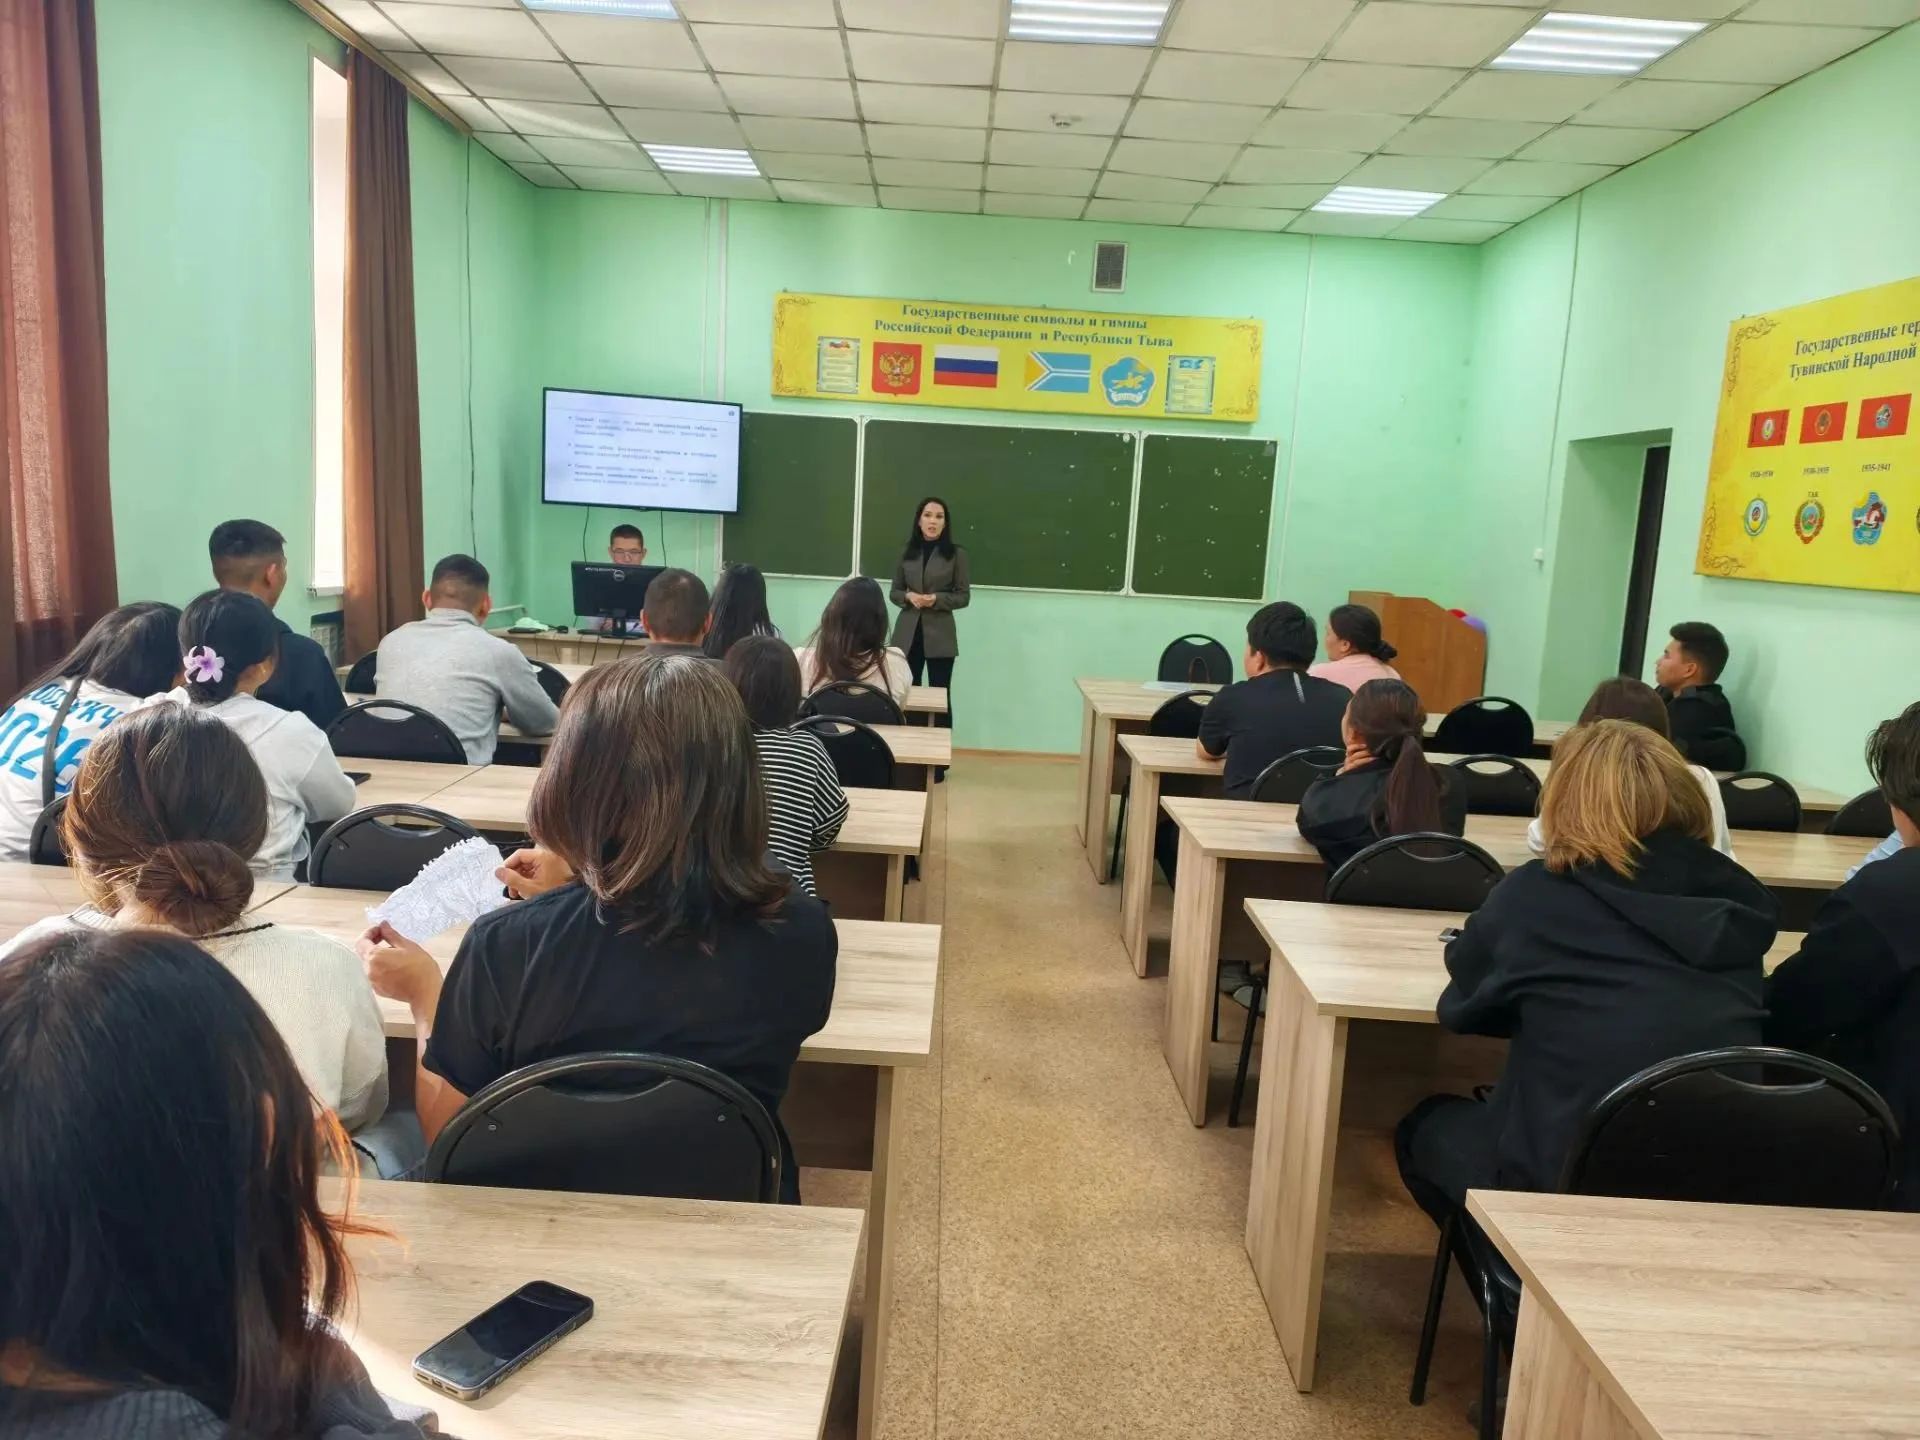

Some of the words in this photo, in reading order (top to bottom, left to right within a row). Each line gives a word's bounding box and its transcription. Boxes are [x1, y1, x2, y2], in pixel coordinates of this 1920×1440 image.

[902, 304, 1020, 323] Государственные
[1023, 314, 1085, 326] символы
[1089, 318, 1097, 327] и
[1101, 319, 1148, 329] гимны
[874, 319, 952, 336] Российской
[956, 325, 1032, 341] Федерации
[1040, 331, 1048, 341] и
[1053, 330, 1133, 345] Республики
[1137, 335, 1174, 347] Тыва
[1795, 325, 1898, 356] Государственные
[1790, 354, 1849, 381] Тувинской
[1852, 342, 1917, 370] Народной
[0, 706, 93, 793] 026
